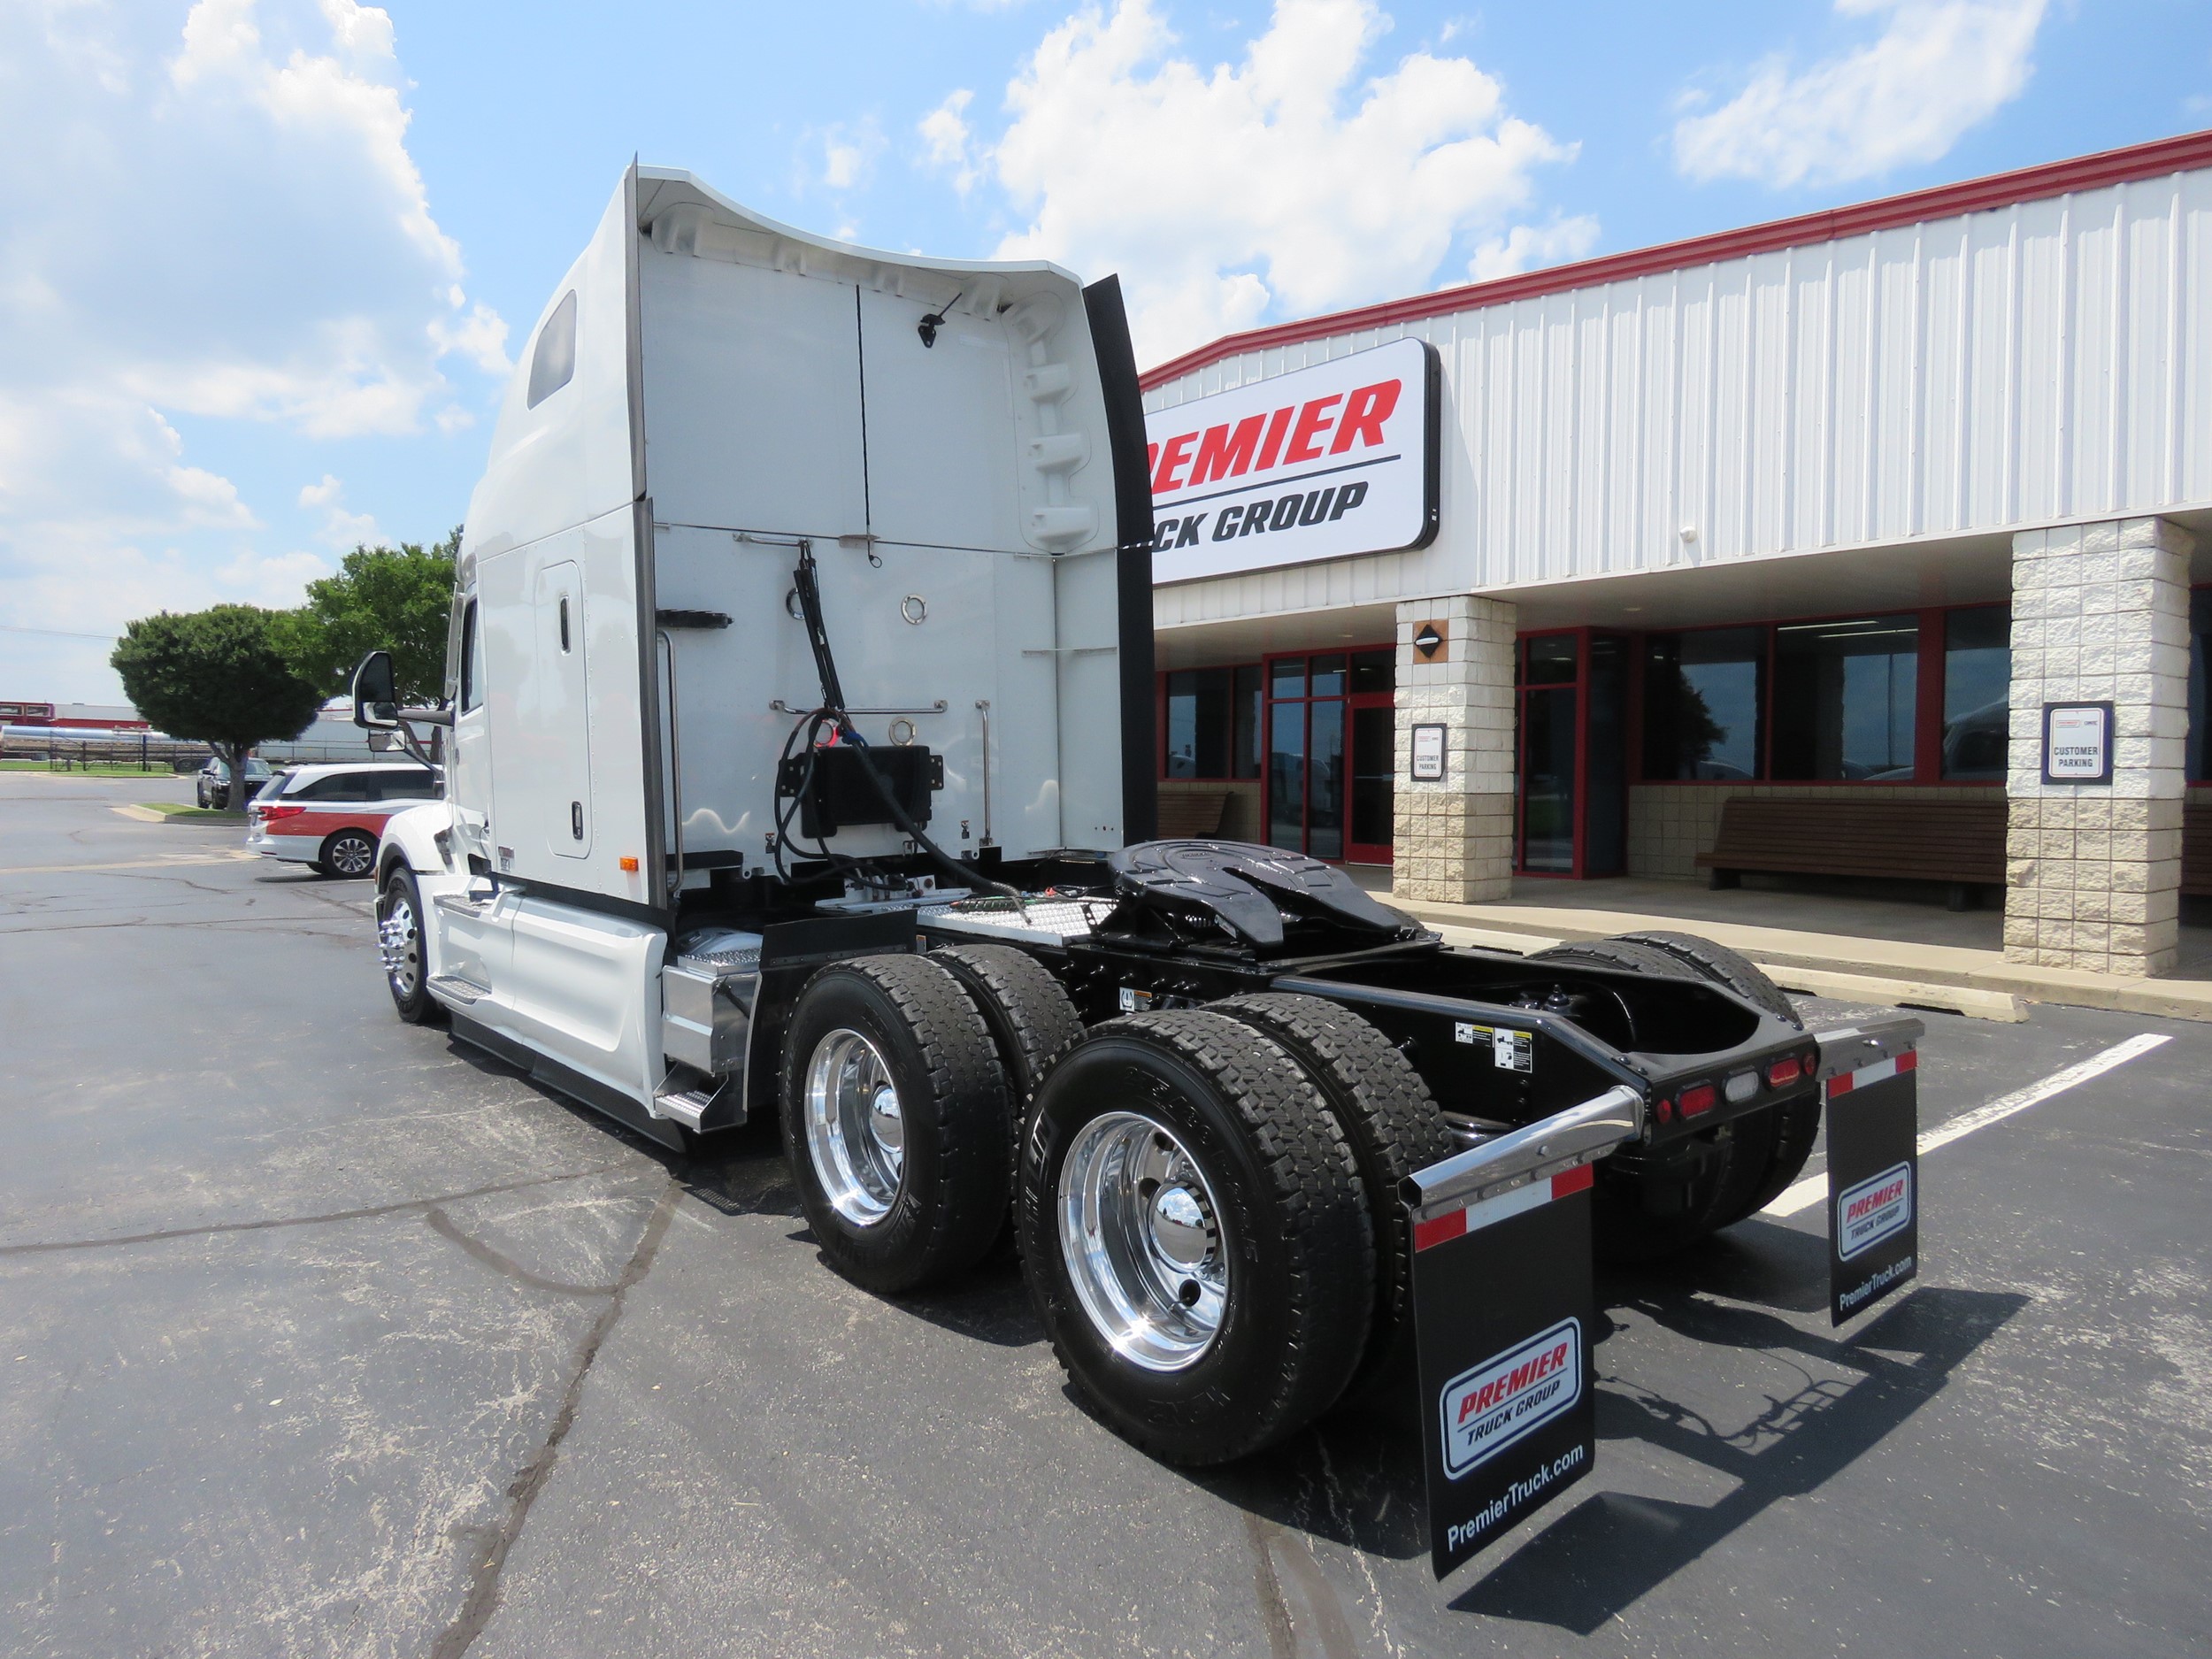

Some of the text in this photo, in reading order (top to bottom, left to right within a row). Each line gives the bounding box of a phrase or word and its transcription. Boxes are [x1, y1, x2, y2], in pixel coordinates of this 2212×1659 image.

[1153, 480, 1369, 553] CK GROUP
[2054, 747, 2098, 756] CUSTOMER
[1847, 1178, 1904, 1223] PREMIER
[1850, 1206, 1900, 1241] TRUCK GROUP
[1839, 1256, 1911, 1311] PremierTruck.com
[1457, 1341, 1568, 1425] PREMIER
[1467, 1379, 1561, 1447] TRUCK GROUP
[1448, 1444, 1584, 1552] PremierTruck.com
